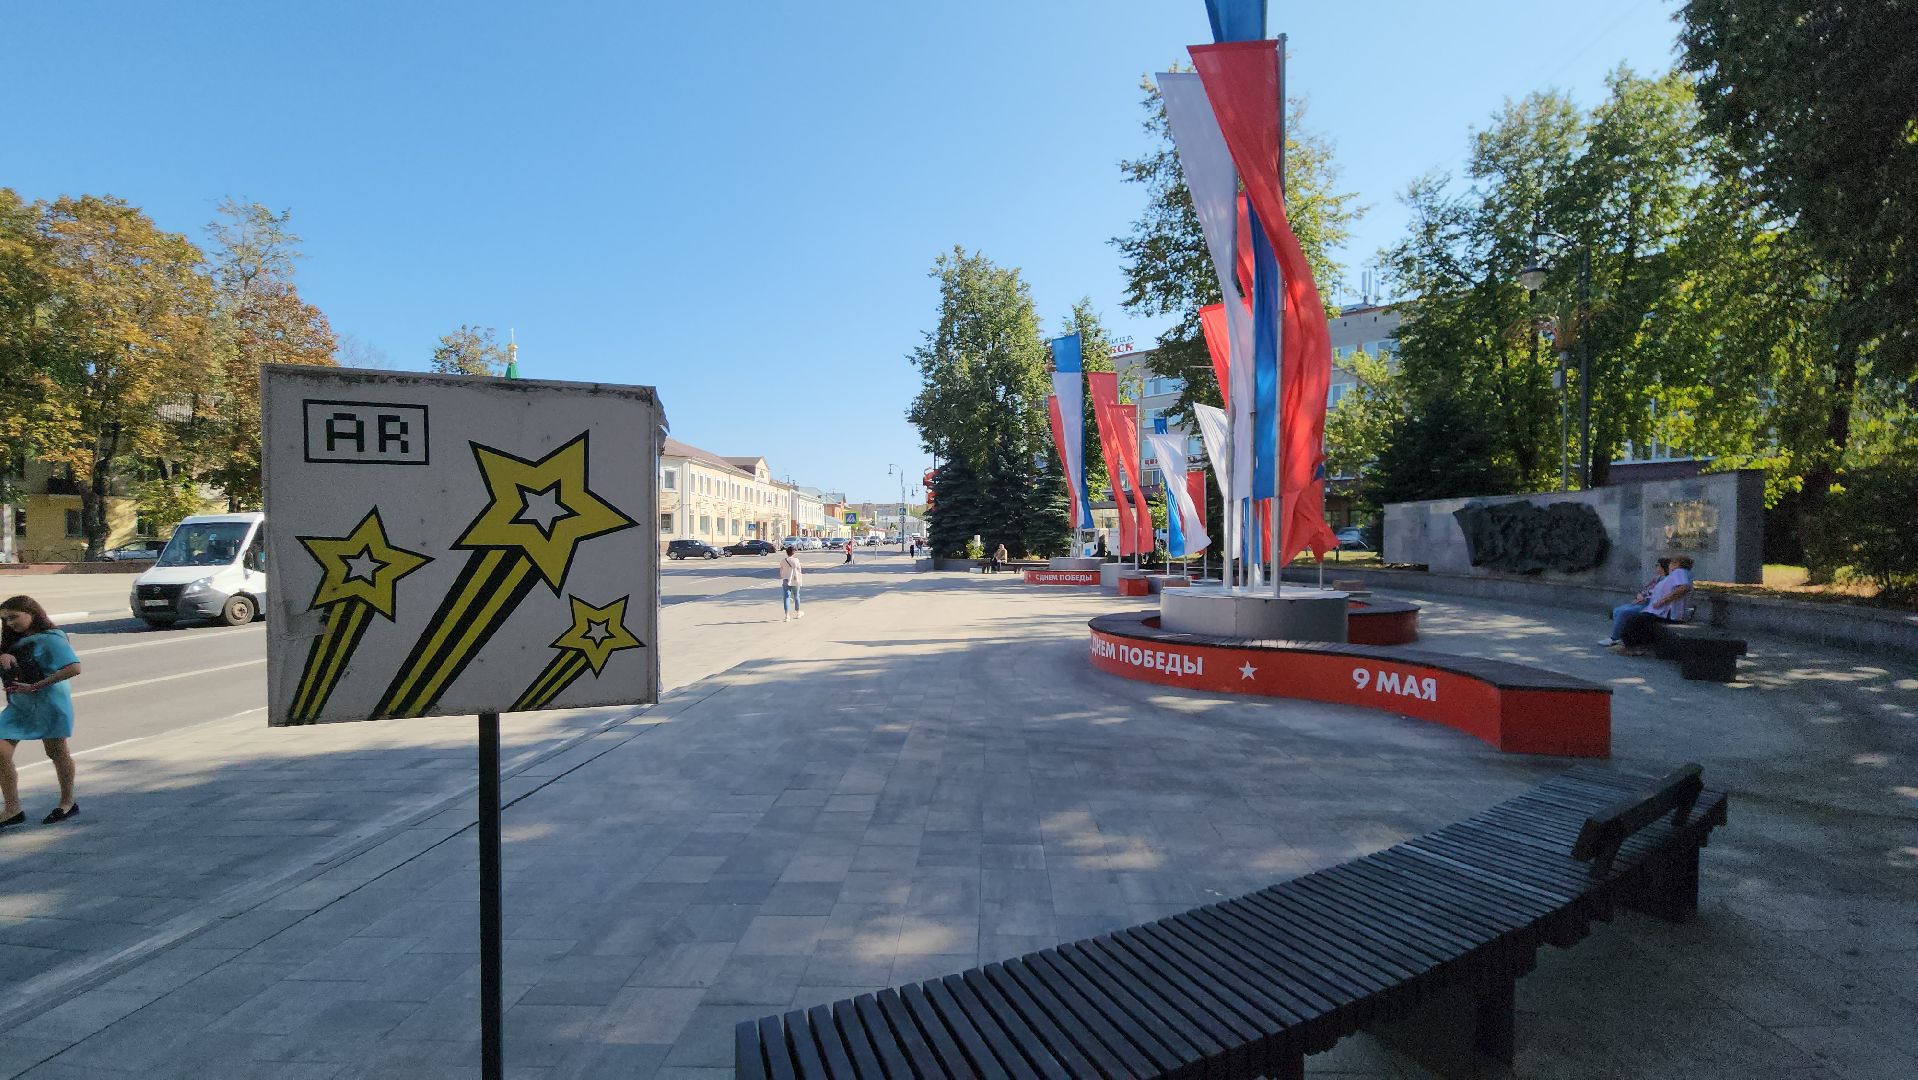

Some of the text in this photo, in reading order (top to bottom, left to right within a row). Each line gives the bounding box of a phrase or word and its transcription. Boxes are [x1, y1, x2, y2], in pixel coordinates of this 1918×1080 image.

[326, 413, 409, 453] AR
[1059, 574, 1092, 582] ПОБЕДЫ
[1119, 644, 1203, 676] ПОБЕДЫ
[1352, 667, 1437, 702] 9 МАЯ
